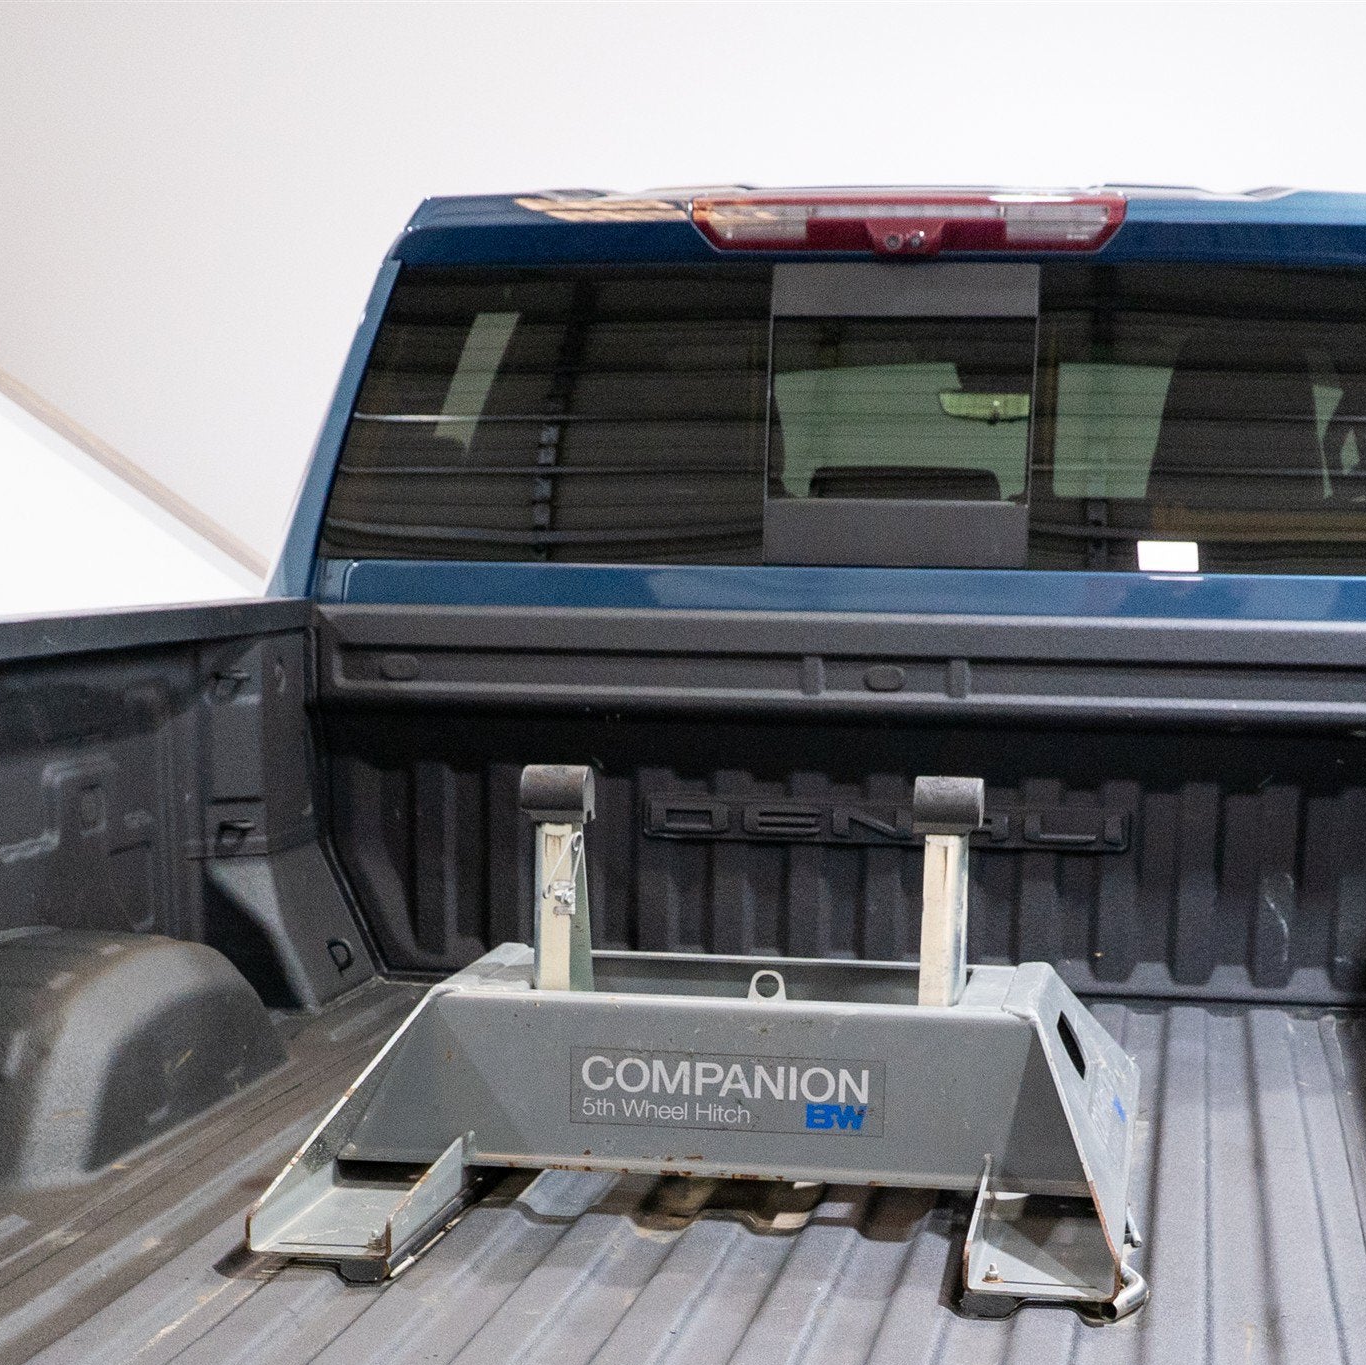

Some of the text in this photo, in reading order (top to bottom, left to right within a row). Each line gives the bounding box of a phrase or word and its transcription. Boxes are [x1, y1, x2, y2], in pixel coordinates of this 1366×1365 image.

[581, 1055, 870, 1104] COMPANION
[581, 1096, 751, 1125] 5th Wheel Hitch
